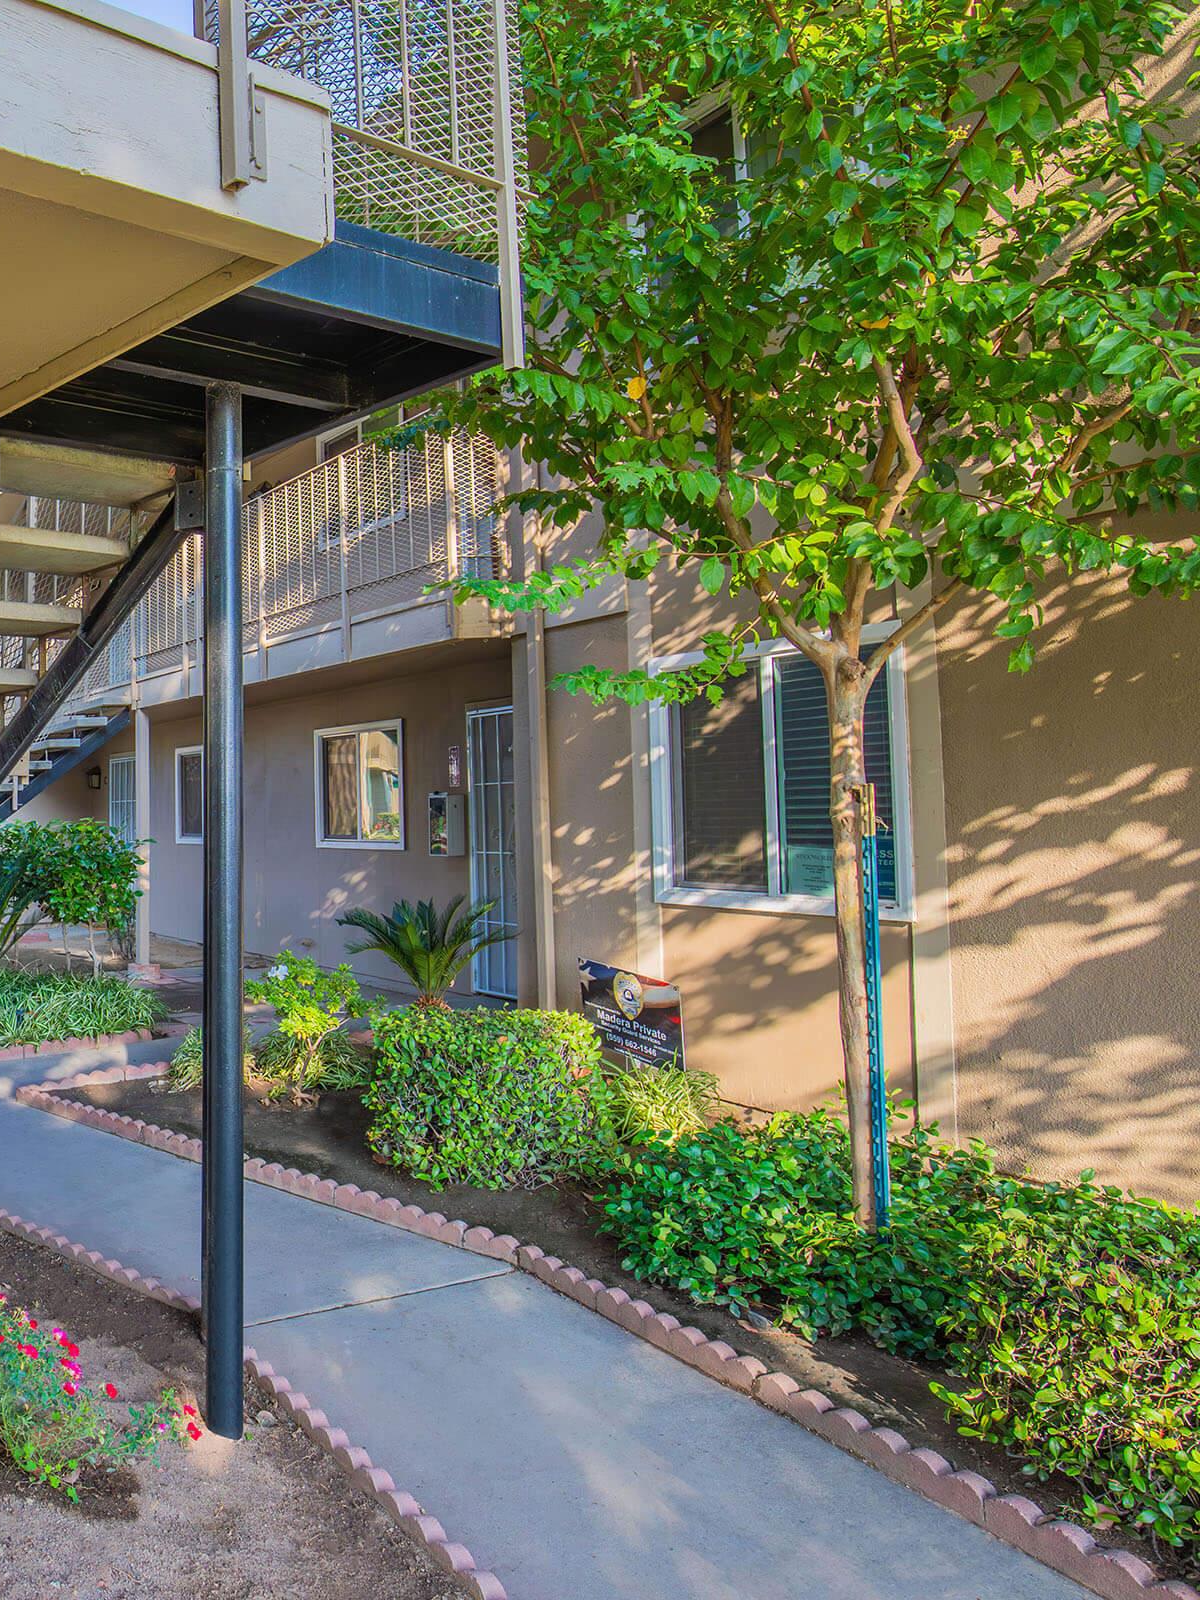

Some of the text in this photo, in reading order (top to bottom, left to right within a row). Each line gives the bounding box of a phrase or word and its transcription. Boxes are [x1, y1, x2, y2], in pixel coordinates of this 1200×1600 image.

[597, 1009, 631, 1028] Madera
[633, 1021, 667, 1041] Private
[601, 1020, 621, 1032] Security
[639, 1033, 661, 1045] Services
